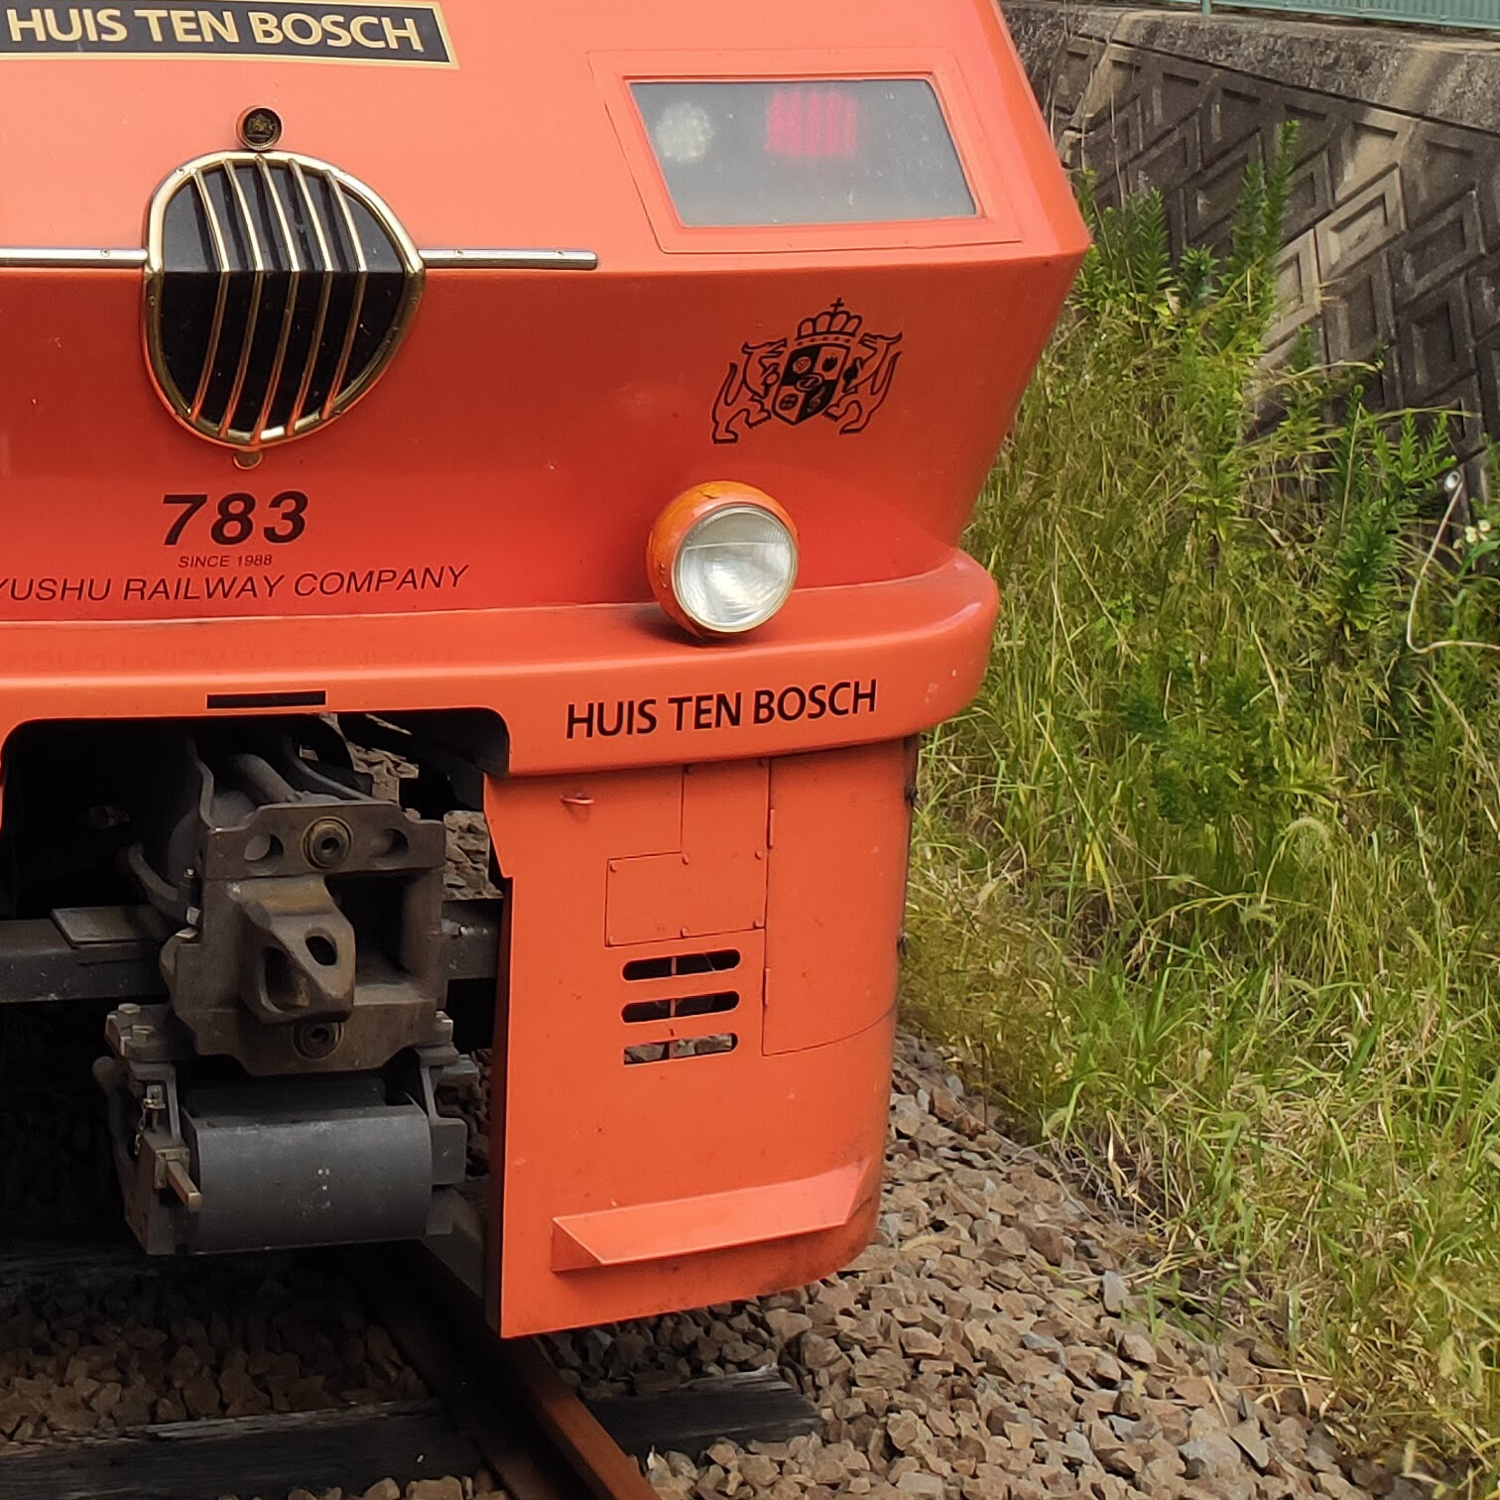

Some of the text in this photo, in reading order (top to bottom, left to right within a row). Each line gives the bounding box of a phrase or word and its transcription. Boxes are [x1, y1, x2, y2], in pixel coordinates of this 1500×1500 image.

[6, 8, 424, 52] HUIS TEN BOSCH
[161, 491, 309, 546] 783
[123, 575, 285, 600] RAILWAY
[293, 565, 469, 596] COMPANY
[178, 554, 272, 568] SINCE 1988
[566, 678, 877, 739] HUIS TEN BOSCH
